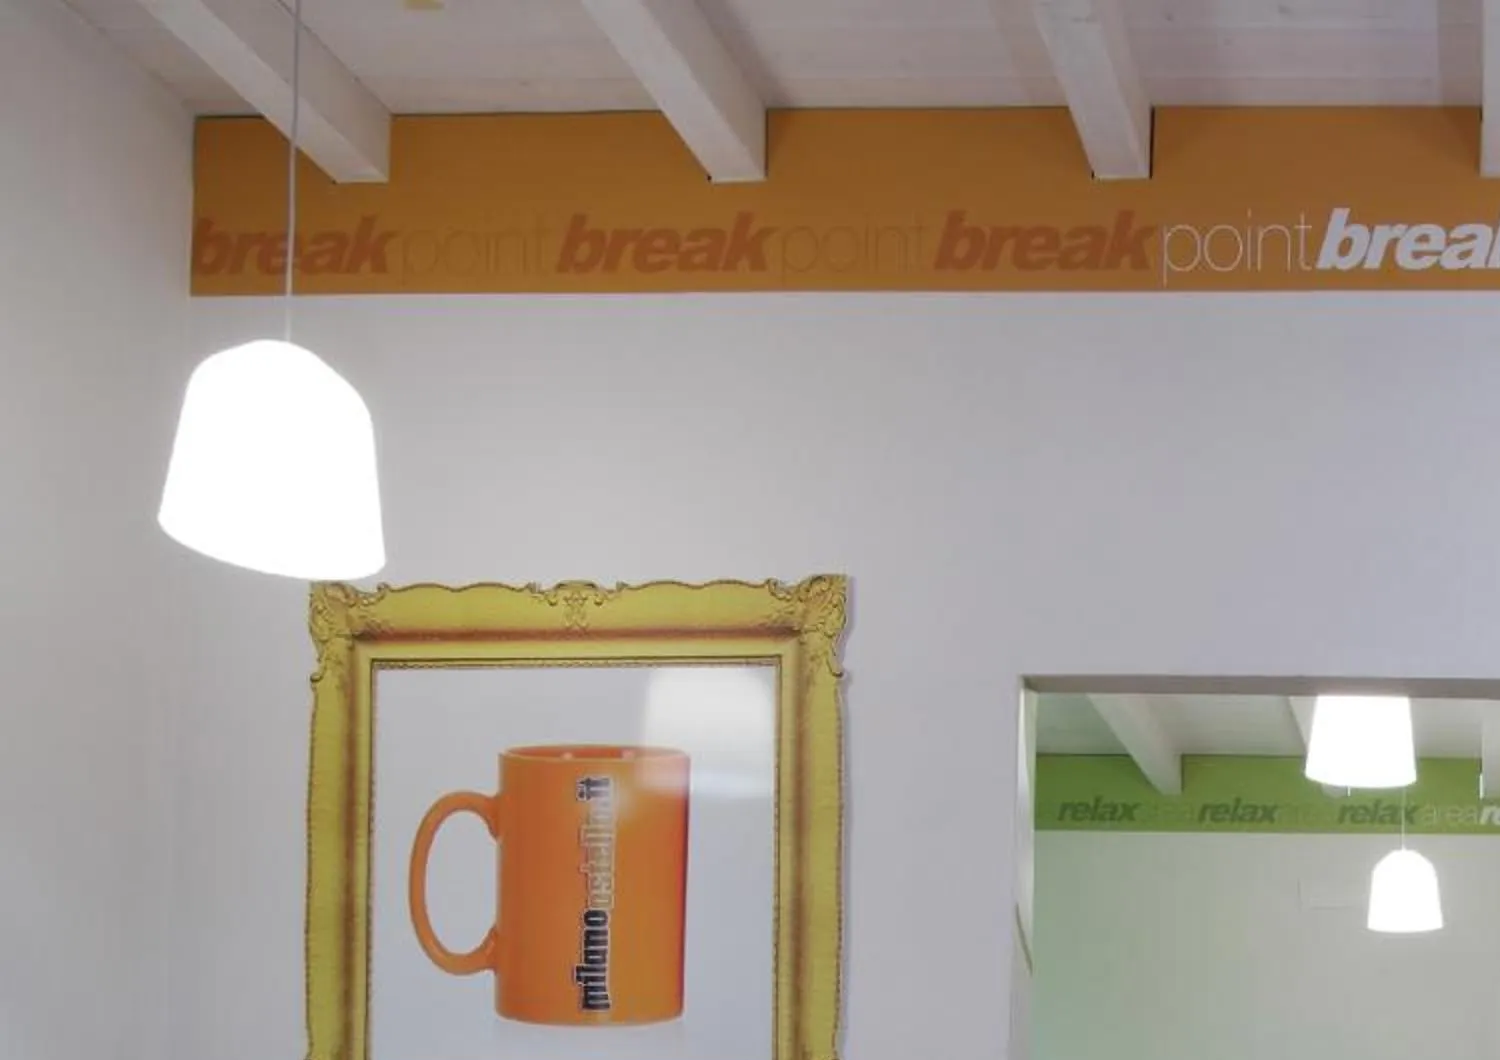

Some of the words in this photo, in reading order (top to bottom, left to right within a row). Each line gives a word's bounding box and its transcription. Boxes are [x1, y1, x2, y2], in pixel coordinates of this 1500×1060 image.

[194, 214, 404, 275] break
[556, 210, 780, 273] break
[780, 211, 934, 287] point
[933, 209, 1159, 272] break
[1162, 208, 1313, 287] point
[1056, 794, 1142, 823] relax
[1197, 796, 1279, 825] relax
[1337, 797, 1418, 825] relax
